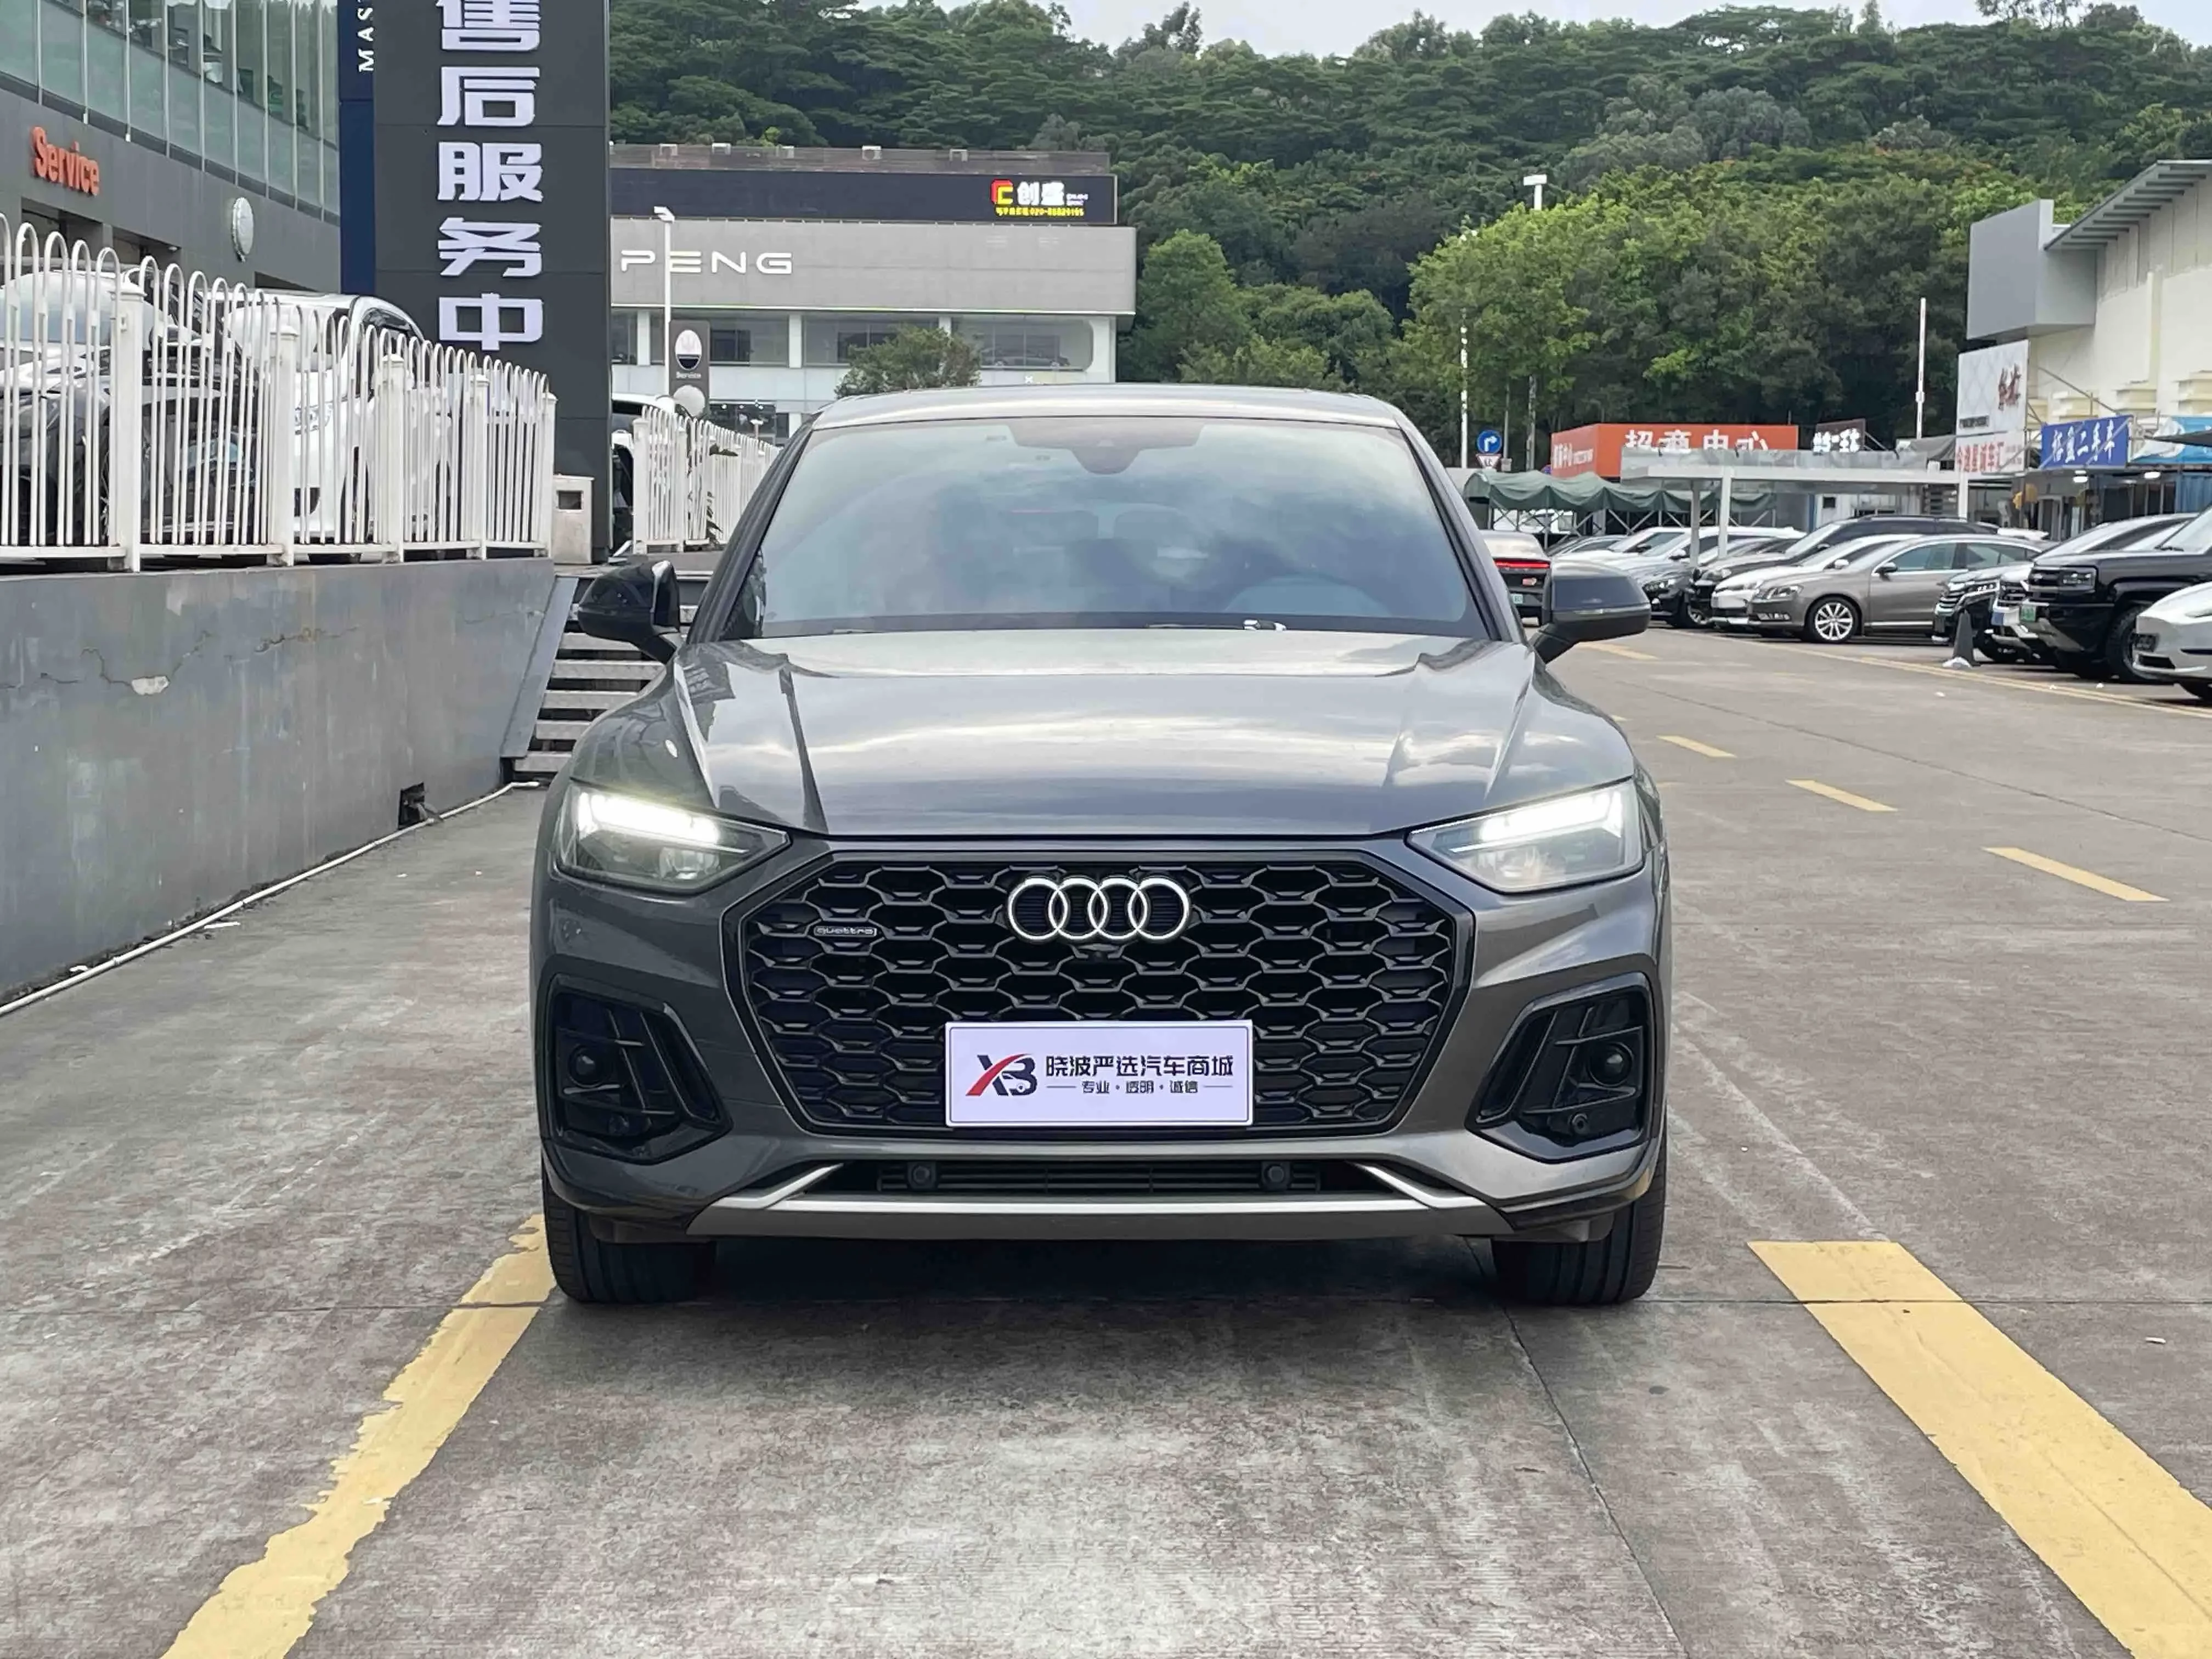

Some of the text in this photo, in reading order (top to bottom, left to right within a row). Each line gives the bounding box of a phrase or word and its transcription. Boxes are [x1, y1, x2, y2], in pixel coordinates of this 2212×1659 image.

[357, 0, 374, 72] MAS
[31, 127, 99, 196] Service
[437, 0, 544, 415] 售后服务中
[621, 250, 792, 274] PENG
[1046, 1056, 1233, 1077] 晓波严选汽车商城
